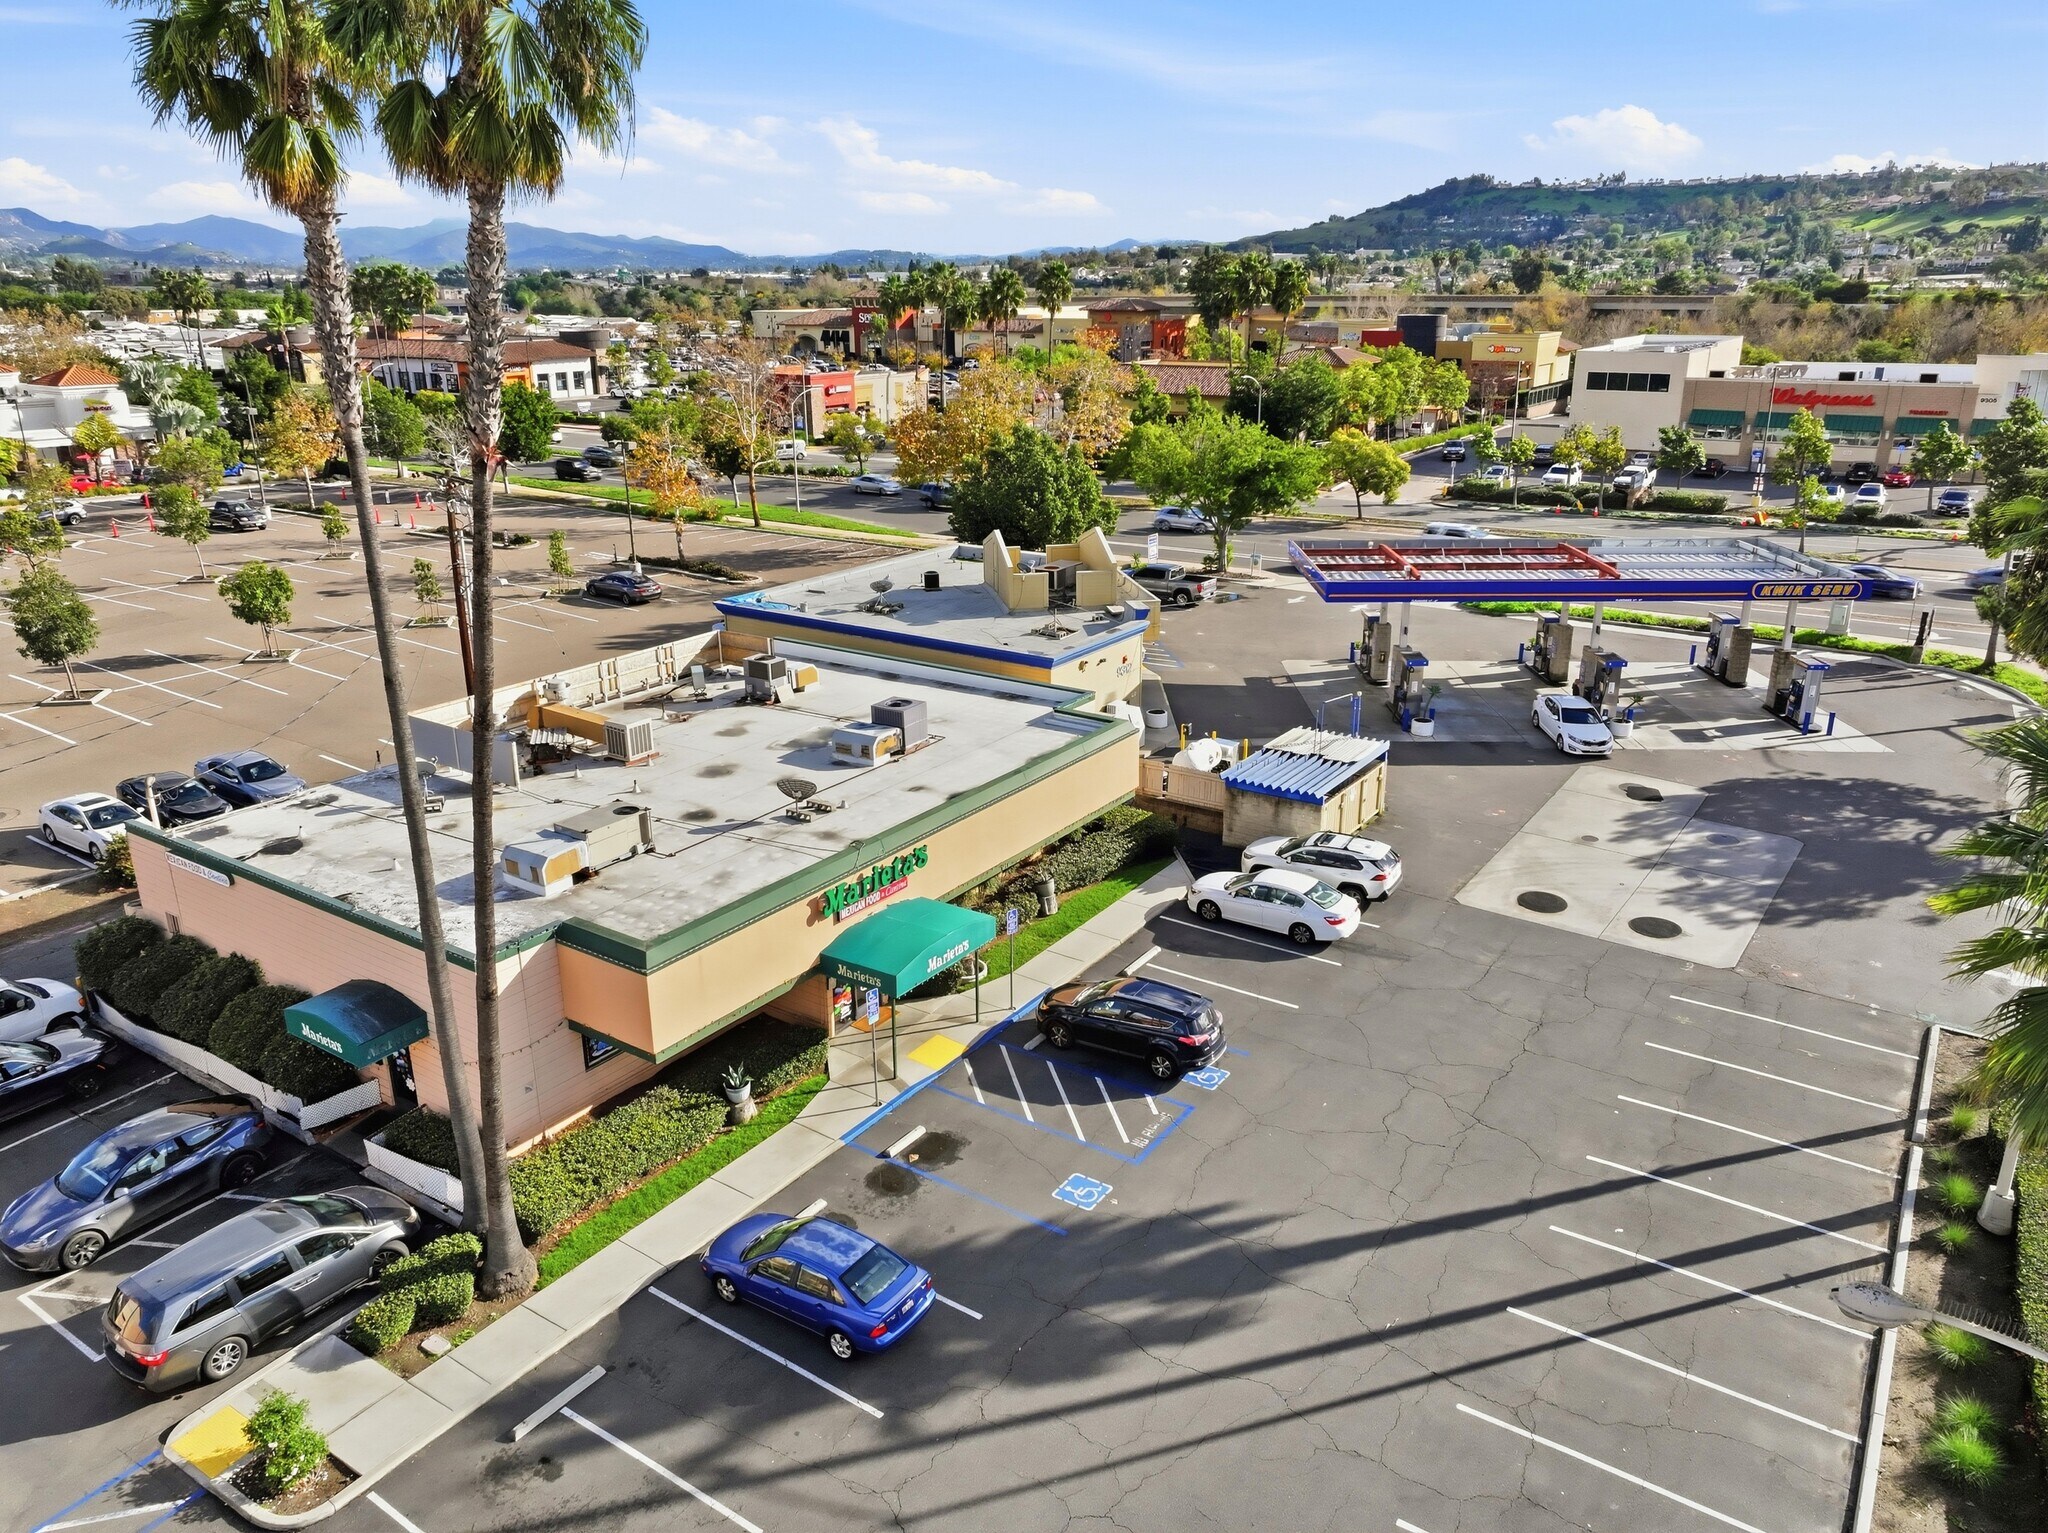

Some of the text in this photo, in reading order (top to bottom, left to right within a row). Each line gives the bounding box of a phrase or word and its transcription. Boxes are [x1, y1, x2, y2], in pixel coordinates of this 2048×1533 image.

[1770, 387, 1876, 411] Walgreens
[1760, 585, 1855, 596] KWIK SERV
[823, 845, 929, 918] Marieta's
[841, 899, 866, 919] MEXICAN
[866, 891, 881, 908] FOOD
[927, 939, 970, 973] Marieta's
[837, 964, 882, 988] Marieta's
[301, 1023, 343, 1054] Marieta's
